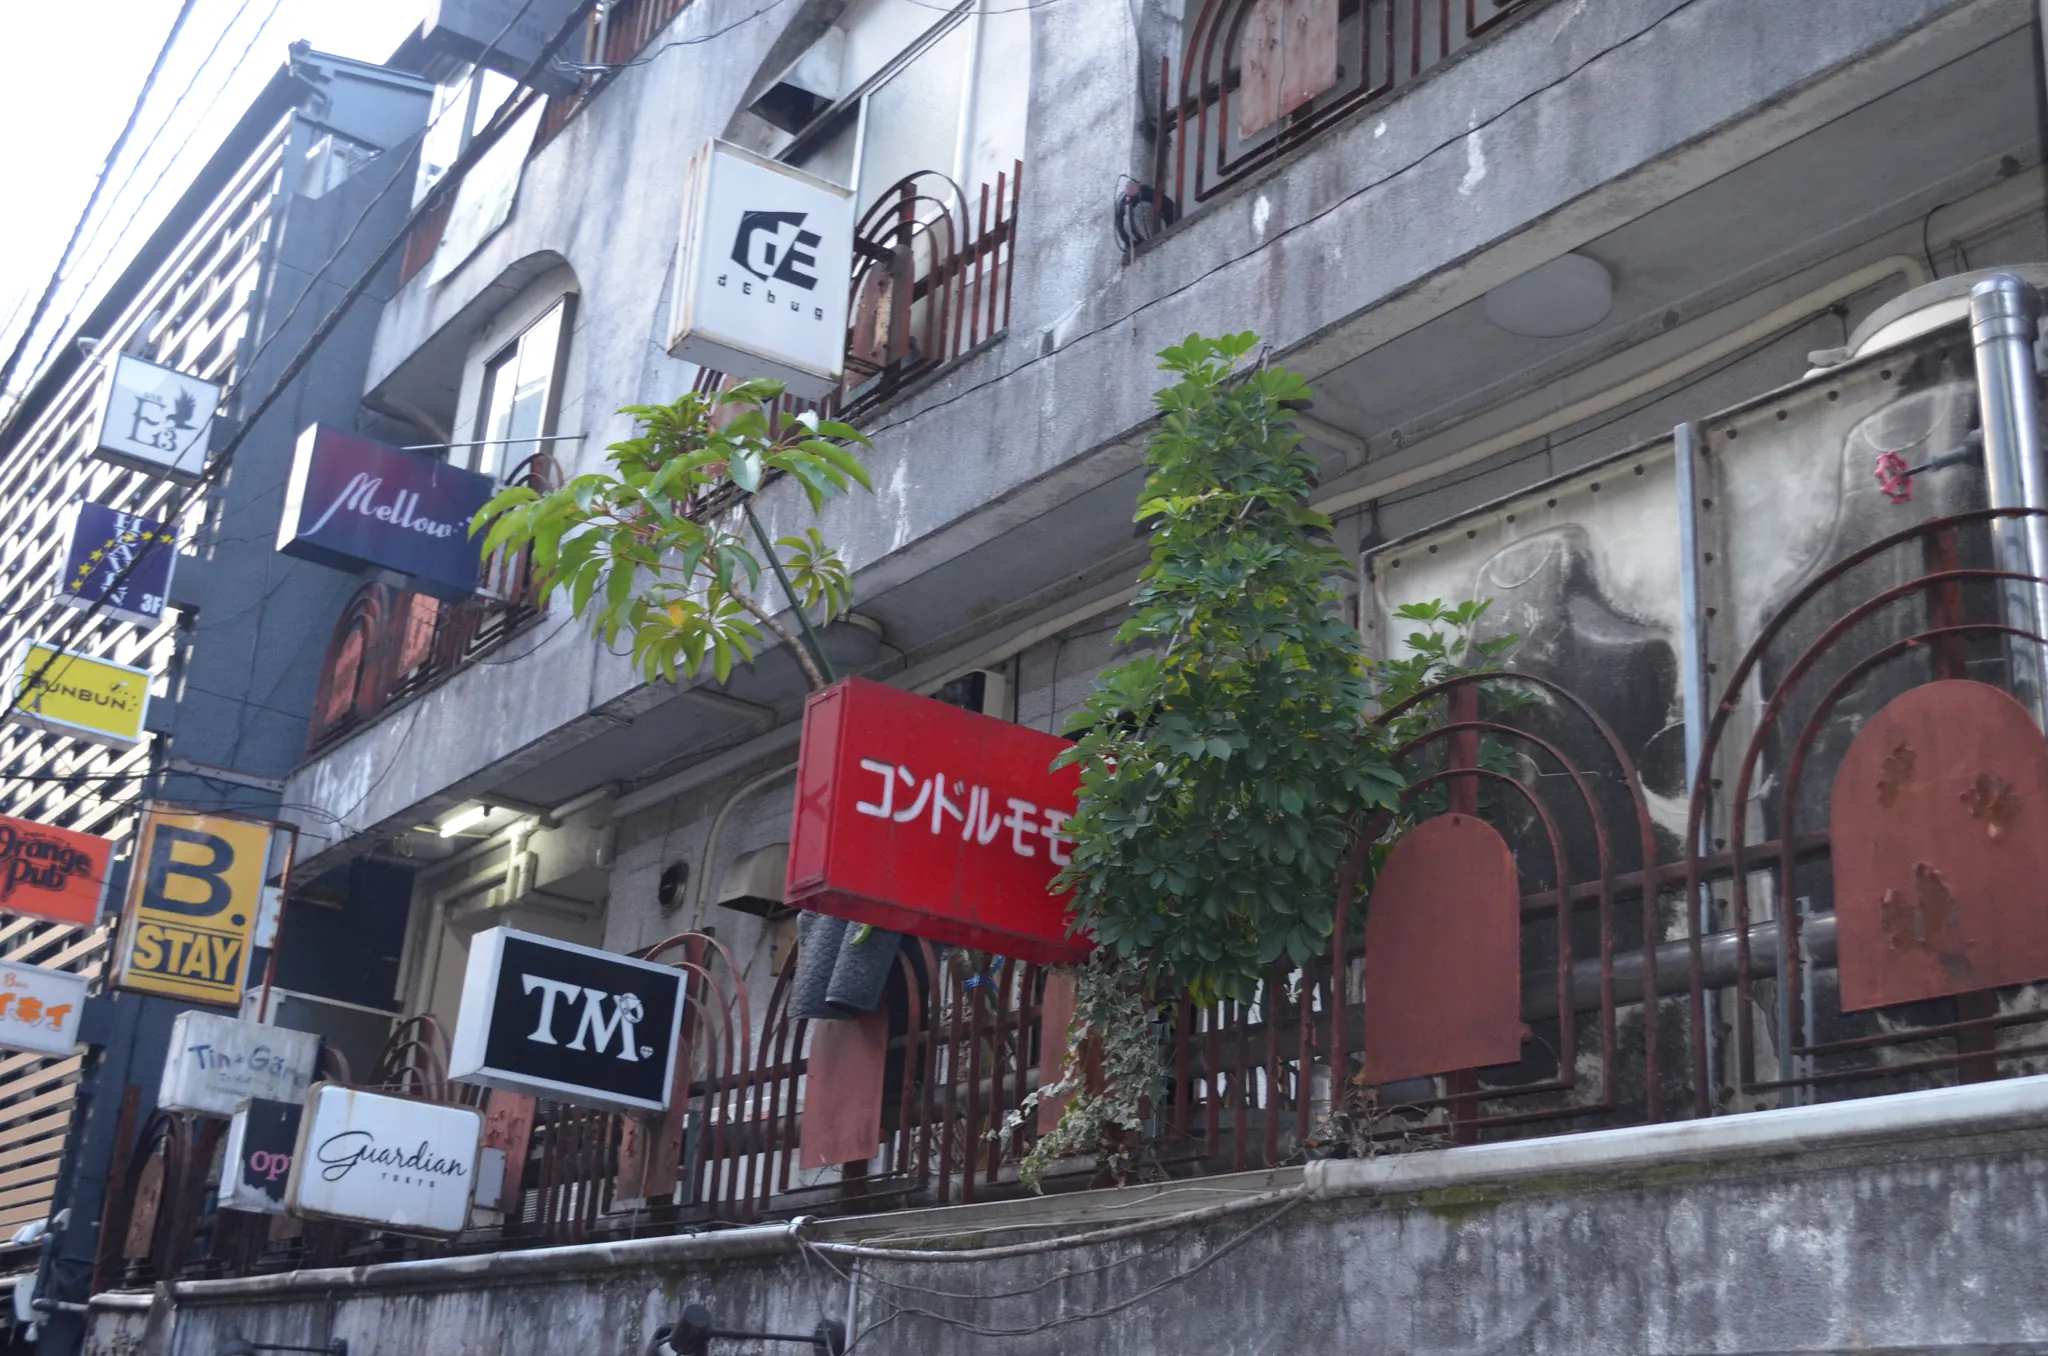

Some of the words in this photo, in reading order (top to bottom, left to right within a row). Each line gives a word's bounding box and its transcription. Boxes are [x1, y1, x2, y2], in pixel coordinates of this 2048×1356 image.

[141, 593, 163, 614] 3F
[29, 677, 126, 710] UNBUN
[132, 924, 242, 982] STAY
[250, 1150, 294, 1181] op
[317, 1130, 467, 1182] Guardian
